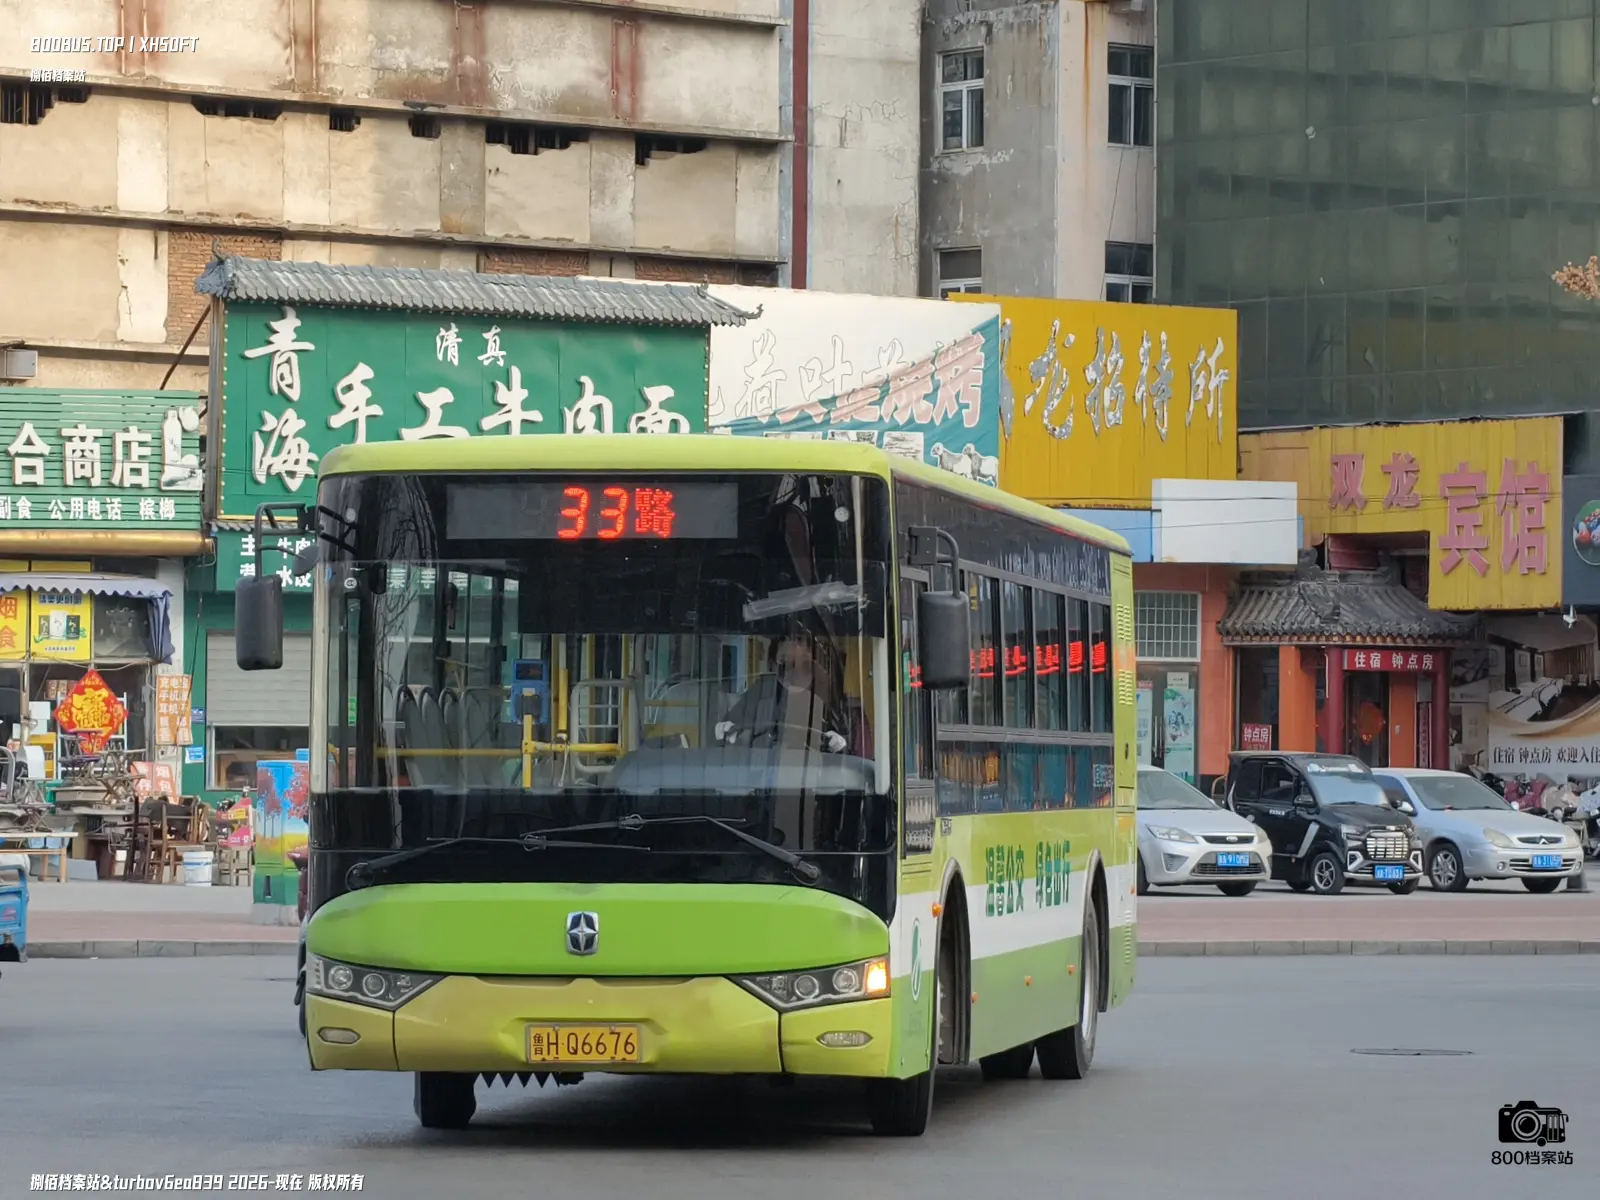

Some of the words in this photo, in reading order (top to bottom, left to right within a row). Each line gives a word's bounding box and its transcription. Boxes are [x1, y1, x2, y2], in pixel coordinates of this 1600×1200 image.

[436, 322, 506, 368] 清真
[243, 305, 320, 492] 青海
[327, 362, 691, 444] 手工牛肉面
[7, 421, 153, 488] 合商店
[48, 498, 123, 521] 公用电话
[557, 486, 675, 538] 33路
[1355, 651, 1381, 668] 住宿
[1392, 652, 1434, 670] 钟点房
[1243, 726, 1269, 742] 钟点房
[1493, 746, 1515, 764] 住宿
[1519, 746, 1552, 764] 钟点房
